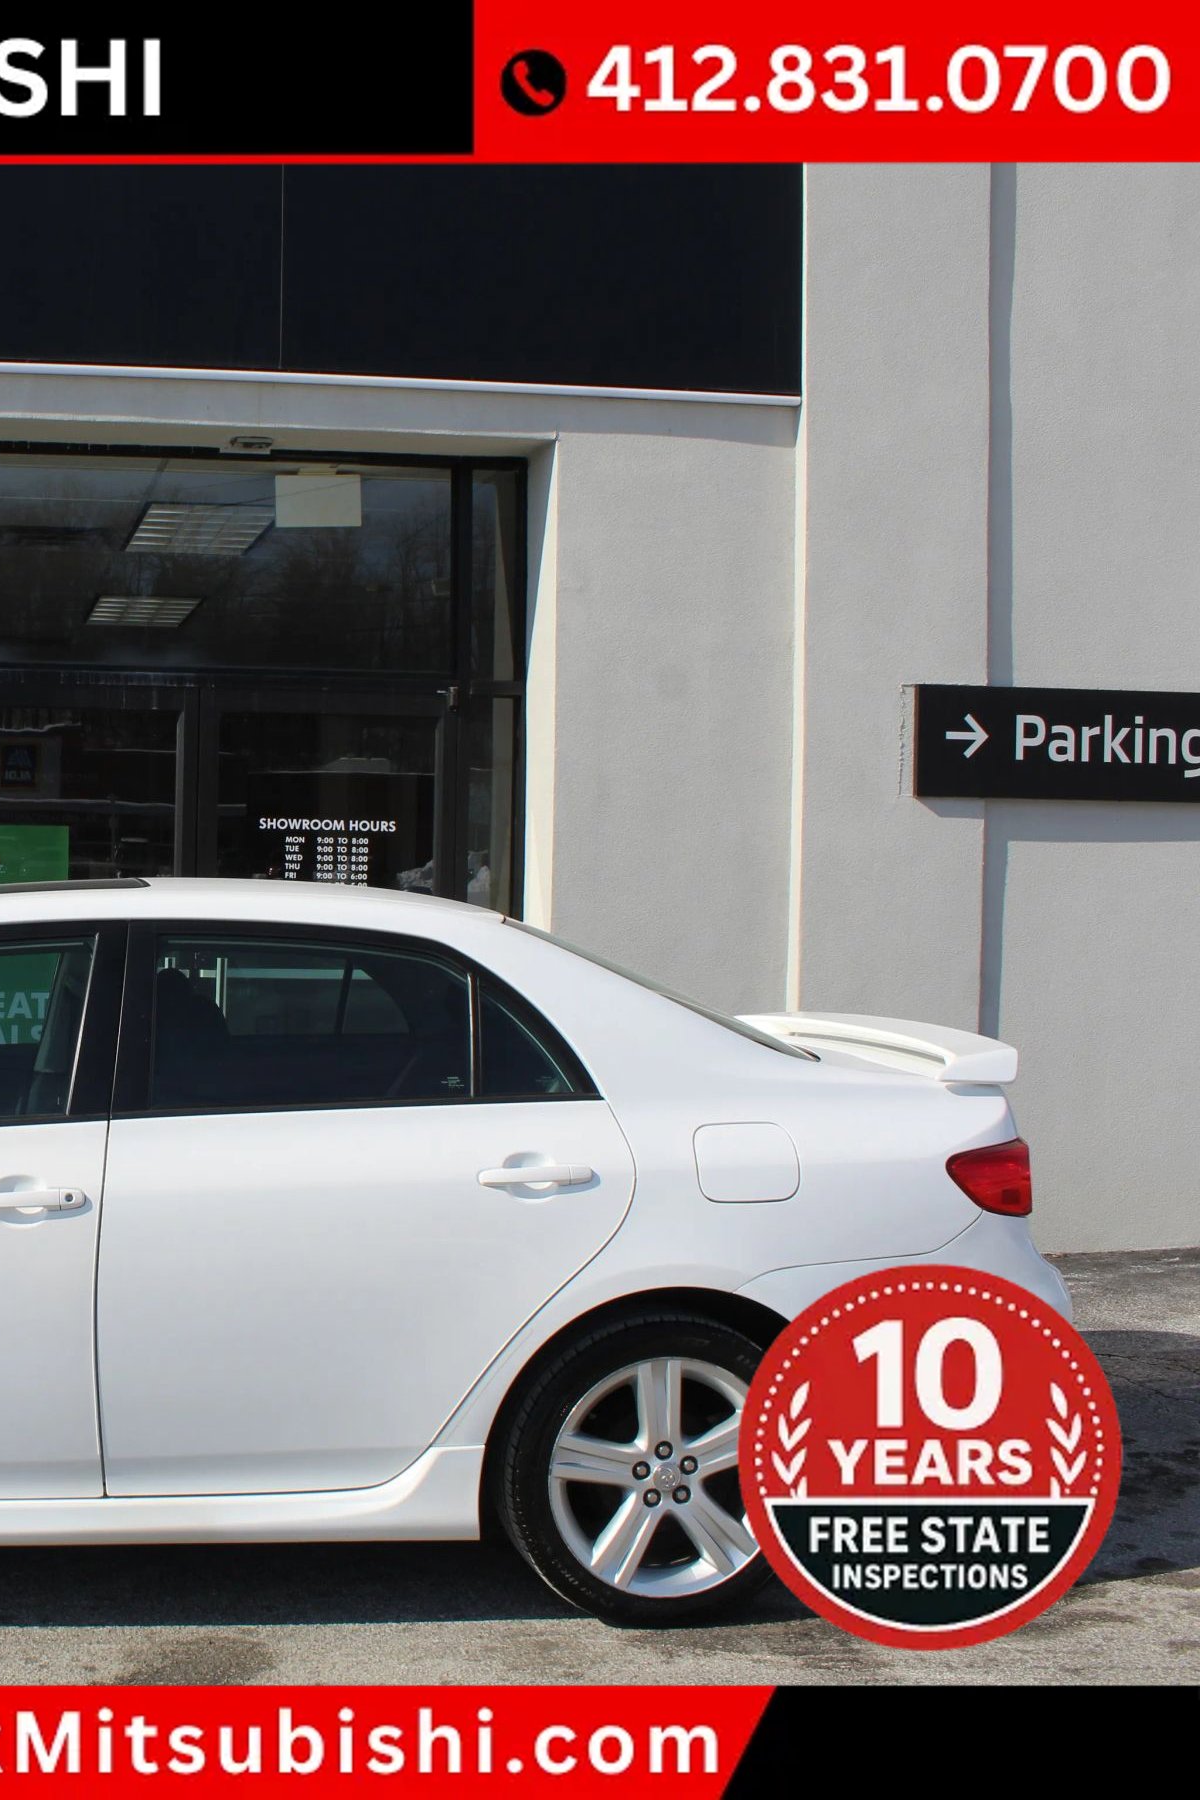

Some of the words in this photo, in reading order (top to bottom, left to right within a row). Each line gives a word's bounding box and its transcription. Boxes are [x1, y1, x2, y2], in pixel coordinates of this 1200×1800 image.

[1015, 714, 1200, 779] Parking
[259, 818, 345, 831] SHOWROOM
[349, 820, 397, 832] HOURS
[285, 836, 305, 844] MON
